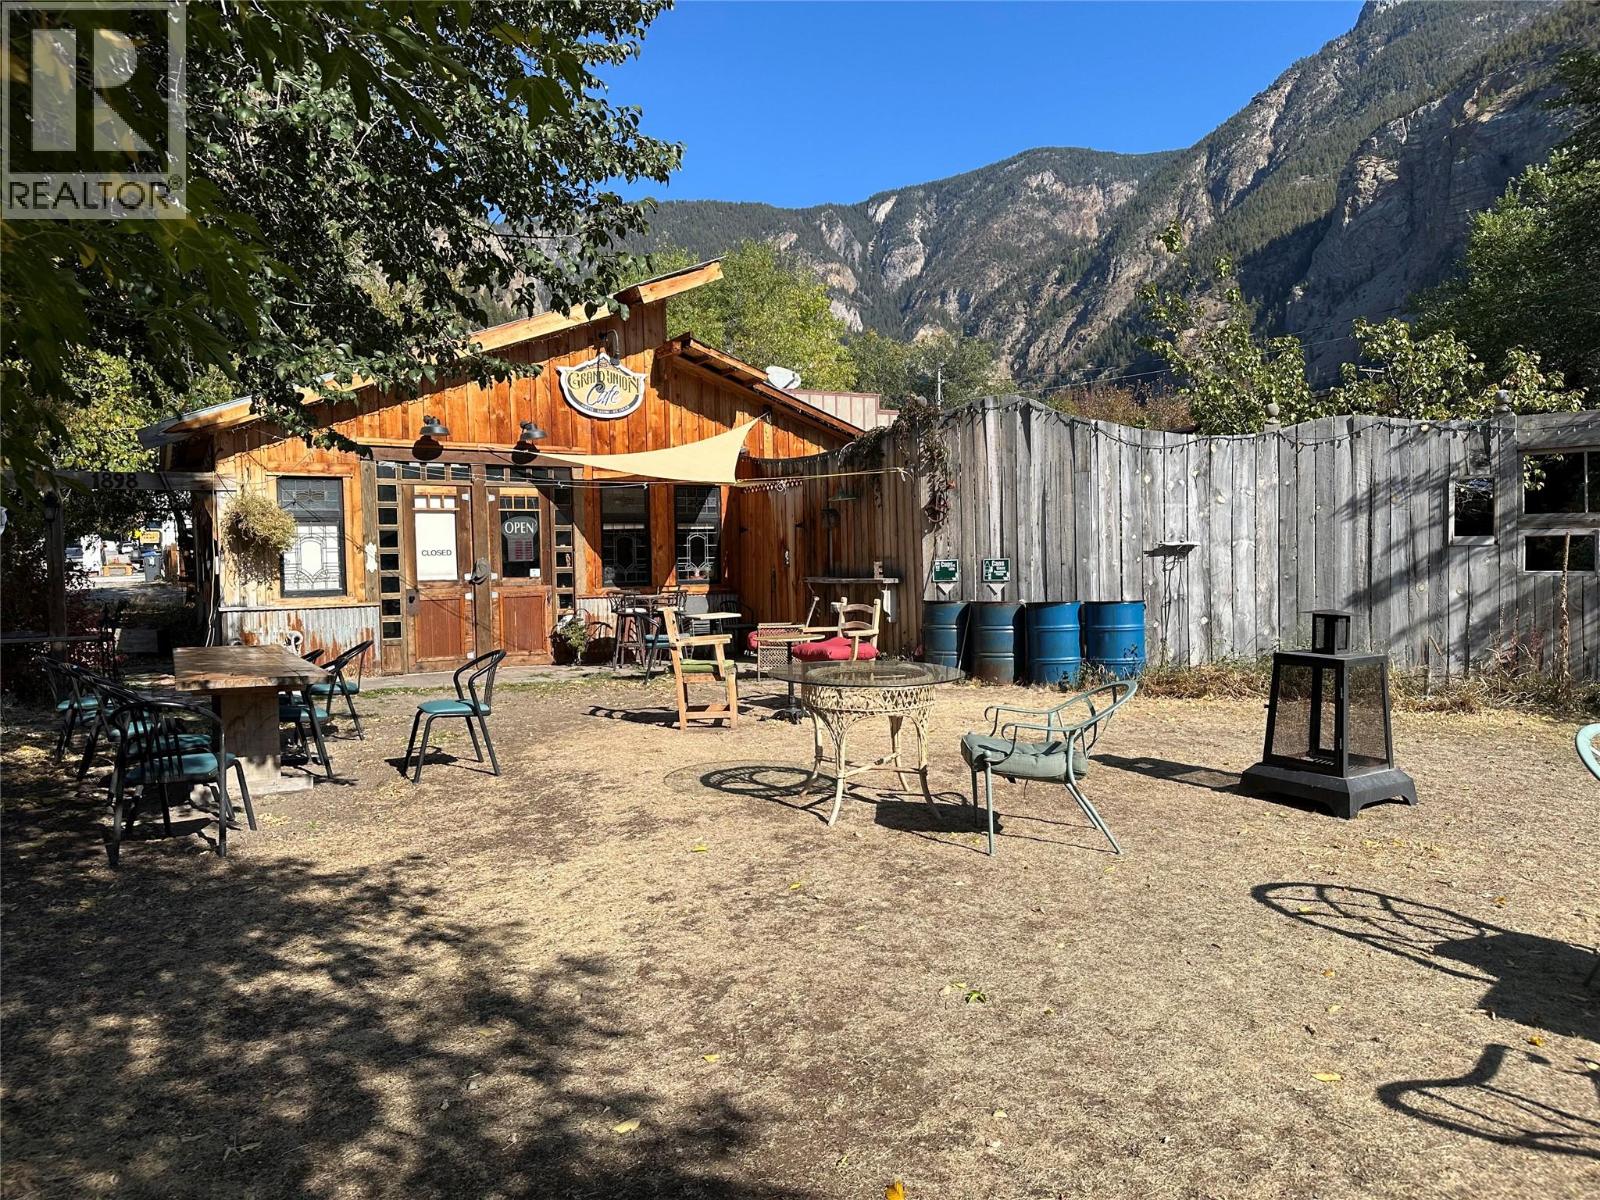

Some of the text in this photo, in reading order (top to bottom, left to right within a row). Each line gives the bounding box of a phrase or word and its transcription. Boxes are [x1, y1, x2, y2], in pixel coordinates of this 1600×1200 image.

[567, 370, 639, 393] GRAND UNION
[91, 472, 138, 488] 1898
[504, 521, 534, 534] OPEN
[421, 549, 452, 557] CLOSED
